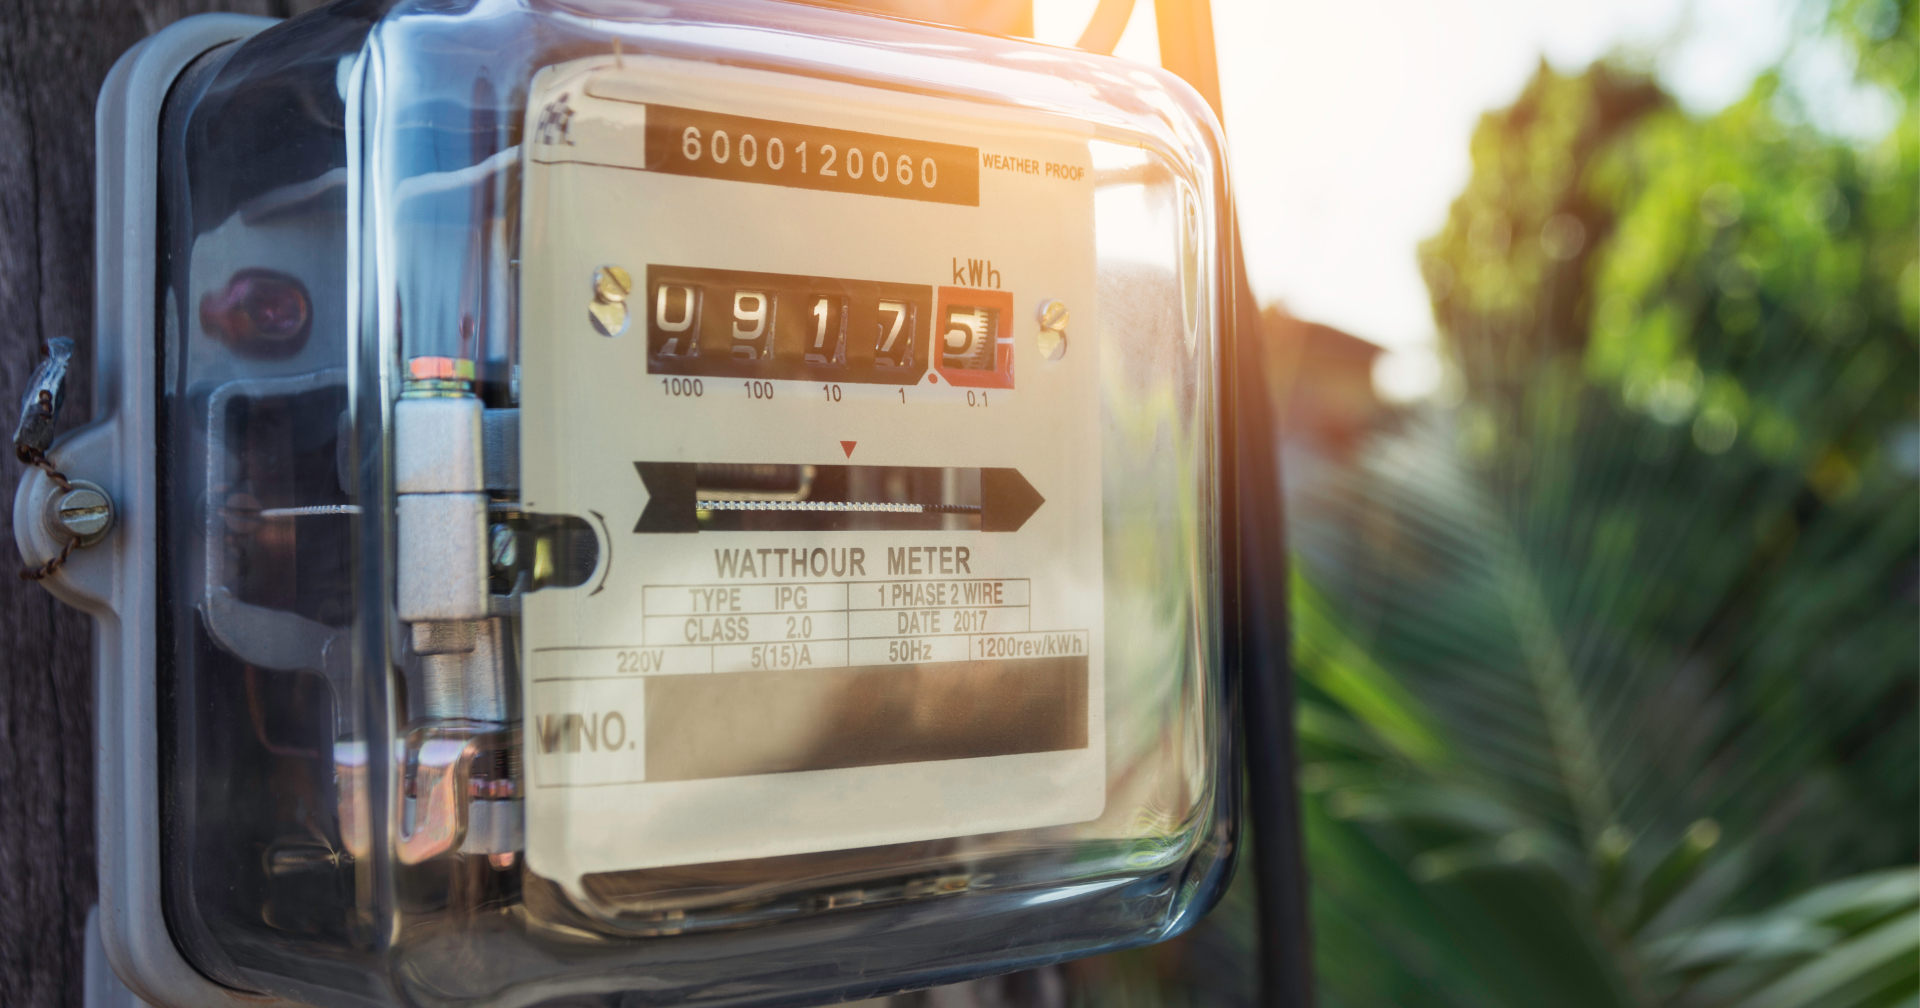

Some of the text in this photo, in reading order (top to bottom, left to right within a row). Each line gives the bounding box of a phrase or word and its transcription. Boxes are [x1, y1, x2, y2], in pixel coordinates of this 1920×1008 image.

[682, 126, 938, 188] 6000120060
[982, 152, 1084, 181] WEATHER PROOF
[952, 257, 1001, 289] kWh
[661, 377, 988, 408] 1000 100 10 1 0.1
[714, 546, 971, 579] WATTHOUR METER
[689, 585, 808, 612] TYPE IPG
[878, 582, 1004, 607] 1 PHASE 2 WIRE
[684, 615, 813, 643] CLASS 2.0
[897, 610, 988, 634] DATE 2017
[751, 643, 813, 671] 5(15)A
[889, 640, 932, 662] 50Hz
[978, 634, 1082, 658] 1200rev/kWh
[616, 650, 663, 674] 220V
